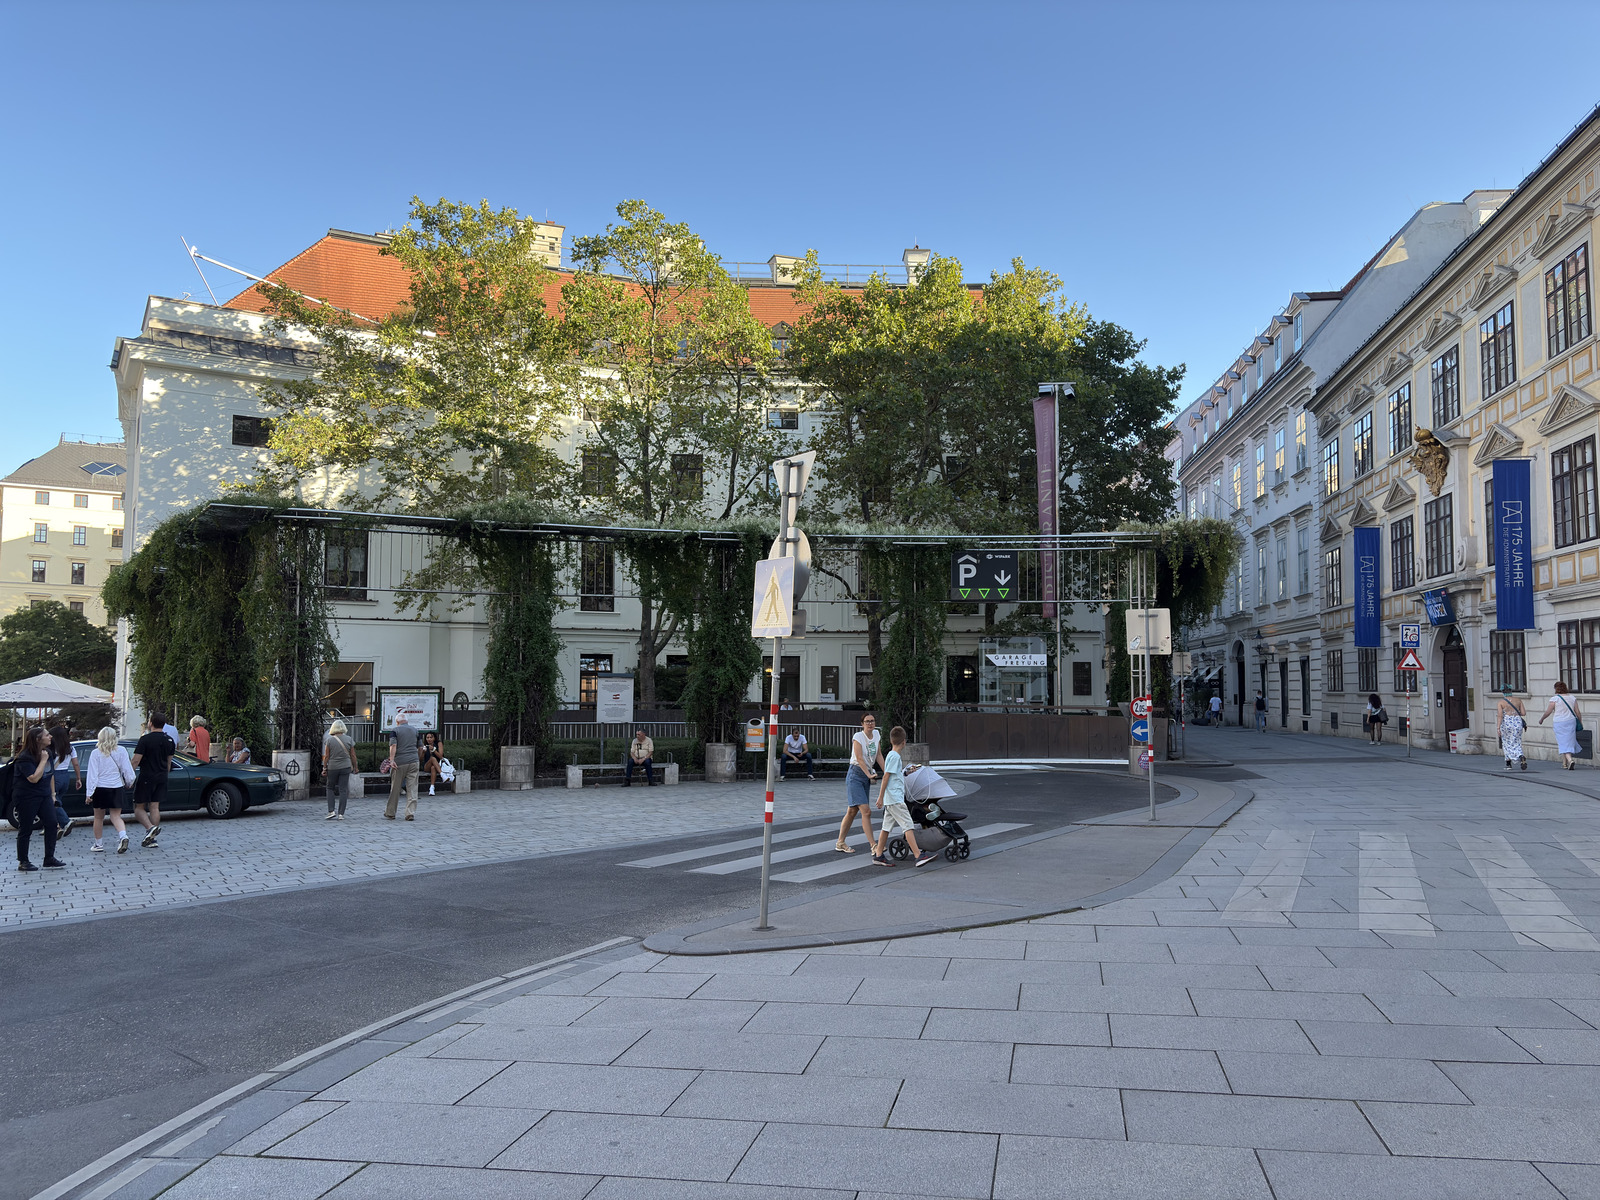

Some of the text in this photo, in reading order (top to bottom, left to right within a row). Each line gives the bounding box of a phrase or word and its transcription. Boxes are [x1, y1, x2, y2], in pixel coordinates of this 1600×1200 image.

[1511, 526, 1524, 588] 175 JAHRE
[1366, 574, 1374, 618] 175 JAHRE
